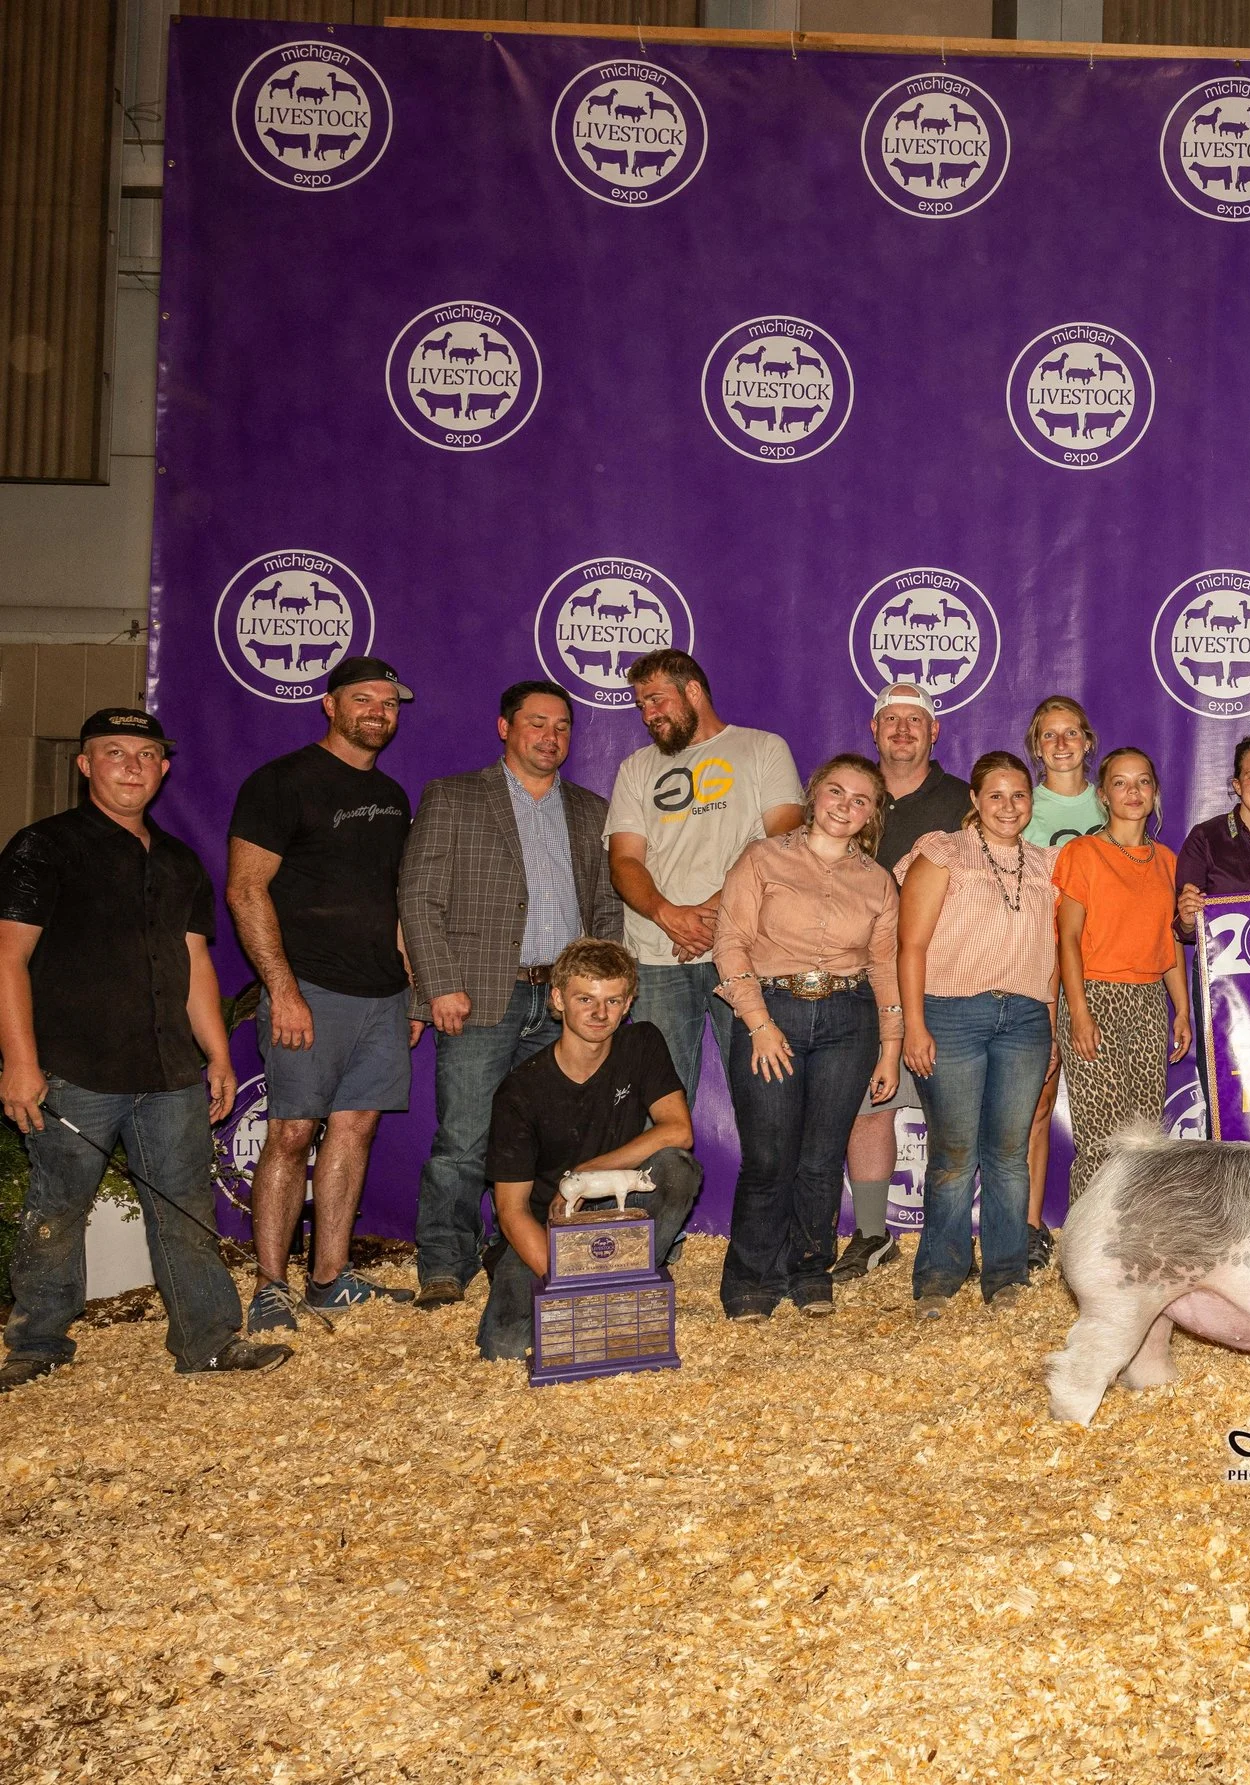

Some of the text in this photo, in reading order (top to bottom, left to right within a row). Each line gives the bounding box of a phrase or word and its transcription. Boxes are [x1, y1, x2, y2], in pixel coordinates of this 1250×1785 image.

[281, 45, 350, 65] michigan
[600, 64, 666, 85] michigan
[907, 77, 970, 96] michigan
[258, 107, 367, 128] LIVESTOCK
[576, 122, 683, 145] LIVESTOCK
[885, 138, 987, 156] LIVESTOCK
[294, 174, 331, 187] expo
[612, 188, 647, 202] expo
[919, 201, 952, 214] expo
[1217, 204, 1250, 217] expo
[435, 305, 501, 325] michigan
[749, 320, 813, 339] michigan
[1052, 326, 1115, 345] michigan
[411, 368, 518, 386] LIVESTOCK
[726, 380, 830, 400] LIVESTOCK
[1030, 388, 1132, 405] LIVESTOCK
[446, 432, 481, 445] expo
[760, 445, 795, 458] expo
[1064, 452, 1098, 465] expo
[264, 554, 333, 574] michigan
[583, 562, 651, 583] michigan
[895, 571, 960, 591] michigan
[240, 618, 349, 636] LIVESTOCK
[559, 624, 669, 645] LIVESTOCK
[873, 634, 976, 651] LIVESTOCK
[276, 685, 312, 698] expo
[595, 691, 632, 705] expo
[1209, 699, 1243, 713] expo
[692, 801, 727, 815] GENETICS
[898, 1209, 925, 1223] exp
